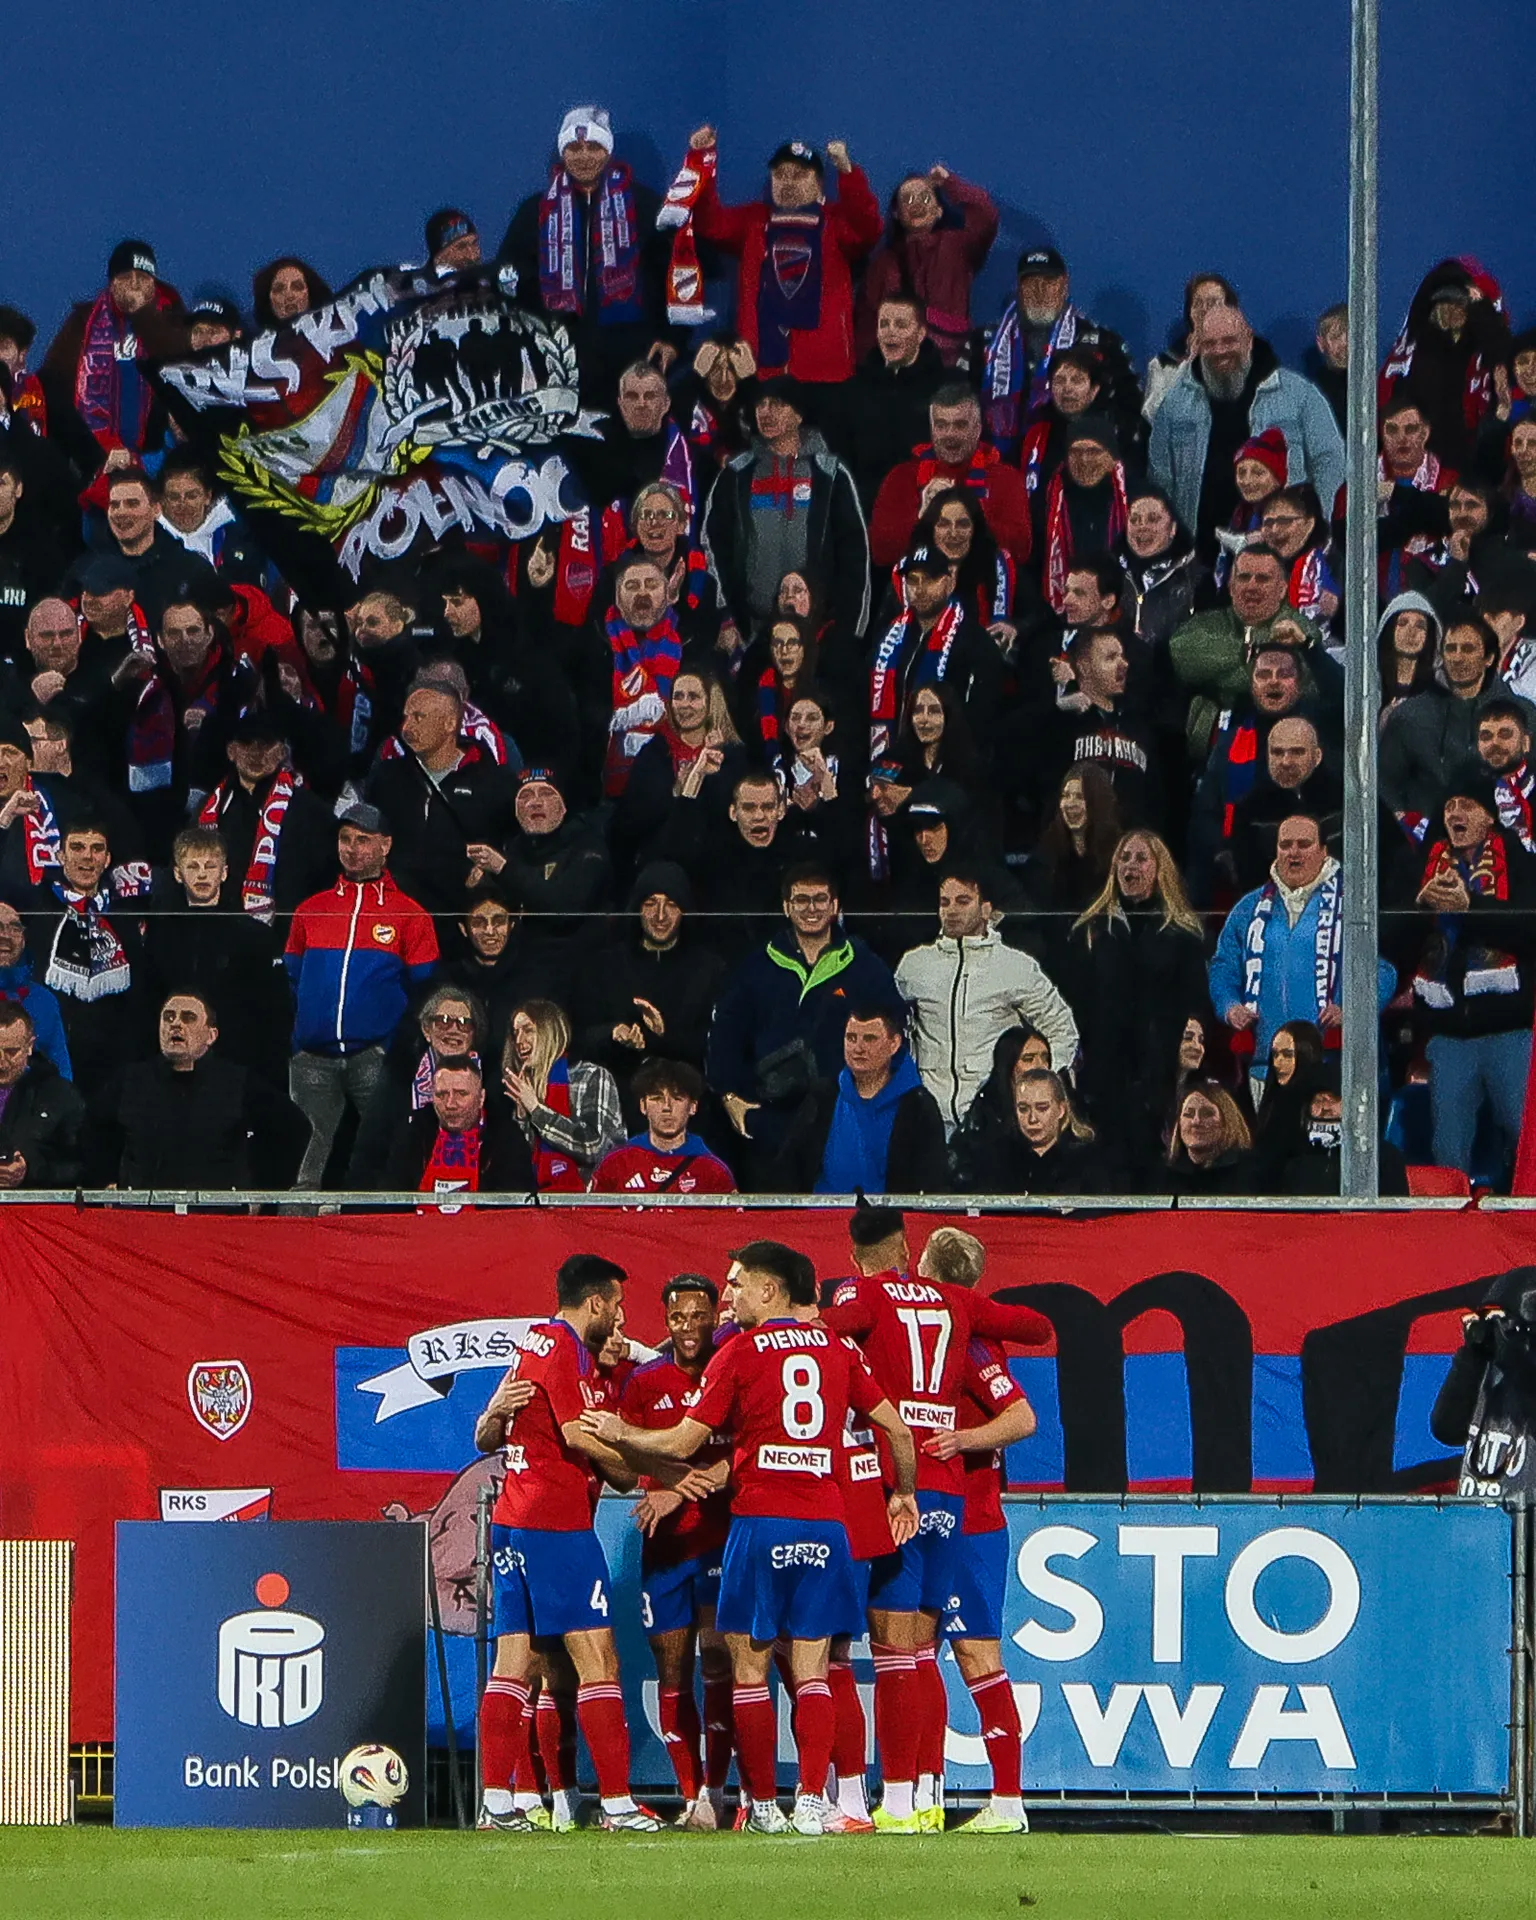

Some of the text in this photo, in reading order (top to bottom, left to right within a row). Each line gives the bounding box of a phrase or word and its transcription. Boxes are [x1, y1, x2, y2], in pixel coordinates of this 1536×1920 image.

[420, 1330, 516, 1368] RKS
[895, 1307, 952, 1394] 17
[782, 1353, 825, 1440] 8
[903, 1406, 954, 1426] NEONET
[763, 1449, 827, 1468] NEONET
[168, 1495, 207, 1511] RKS
[589, 1579, 608, 1617] 4
[217, 1609, 325, 1728] PKO
[185, 1757, 259, 1788] Bank
